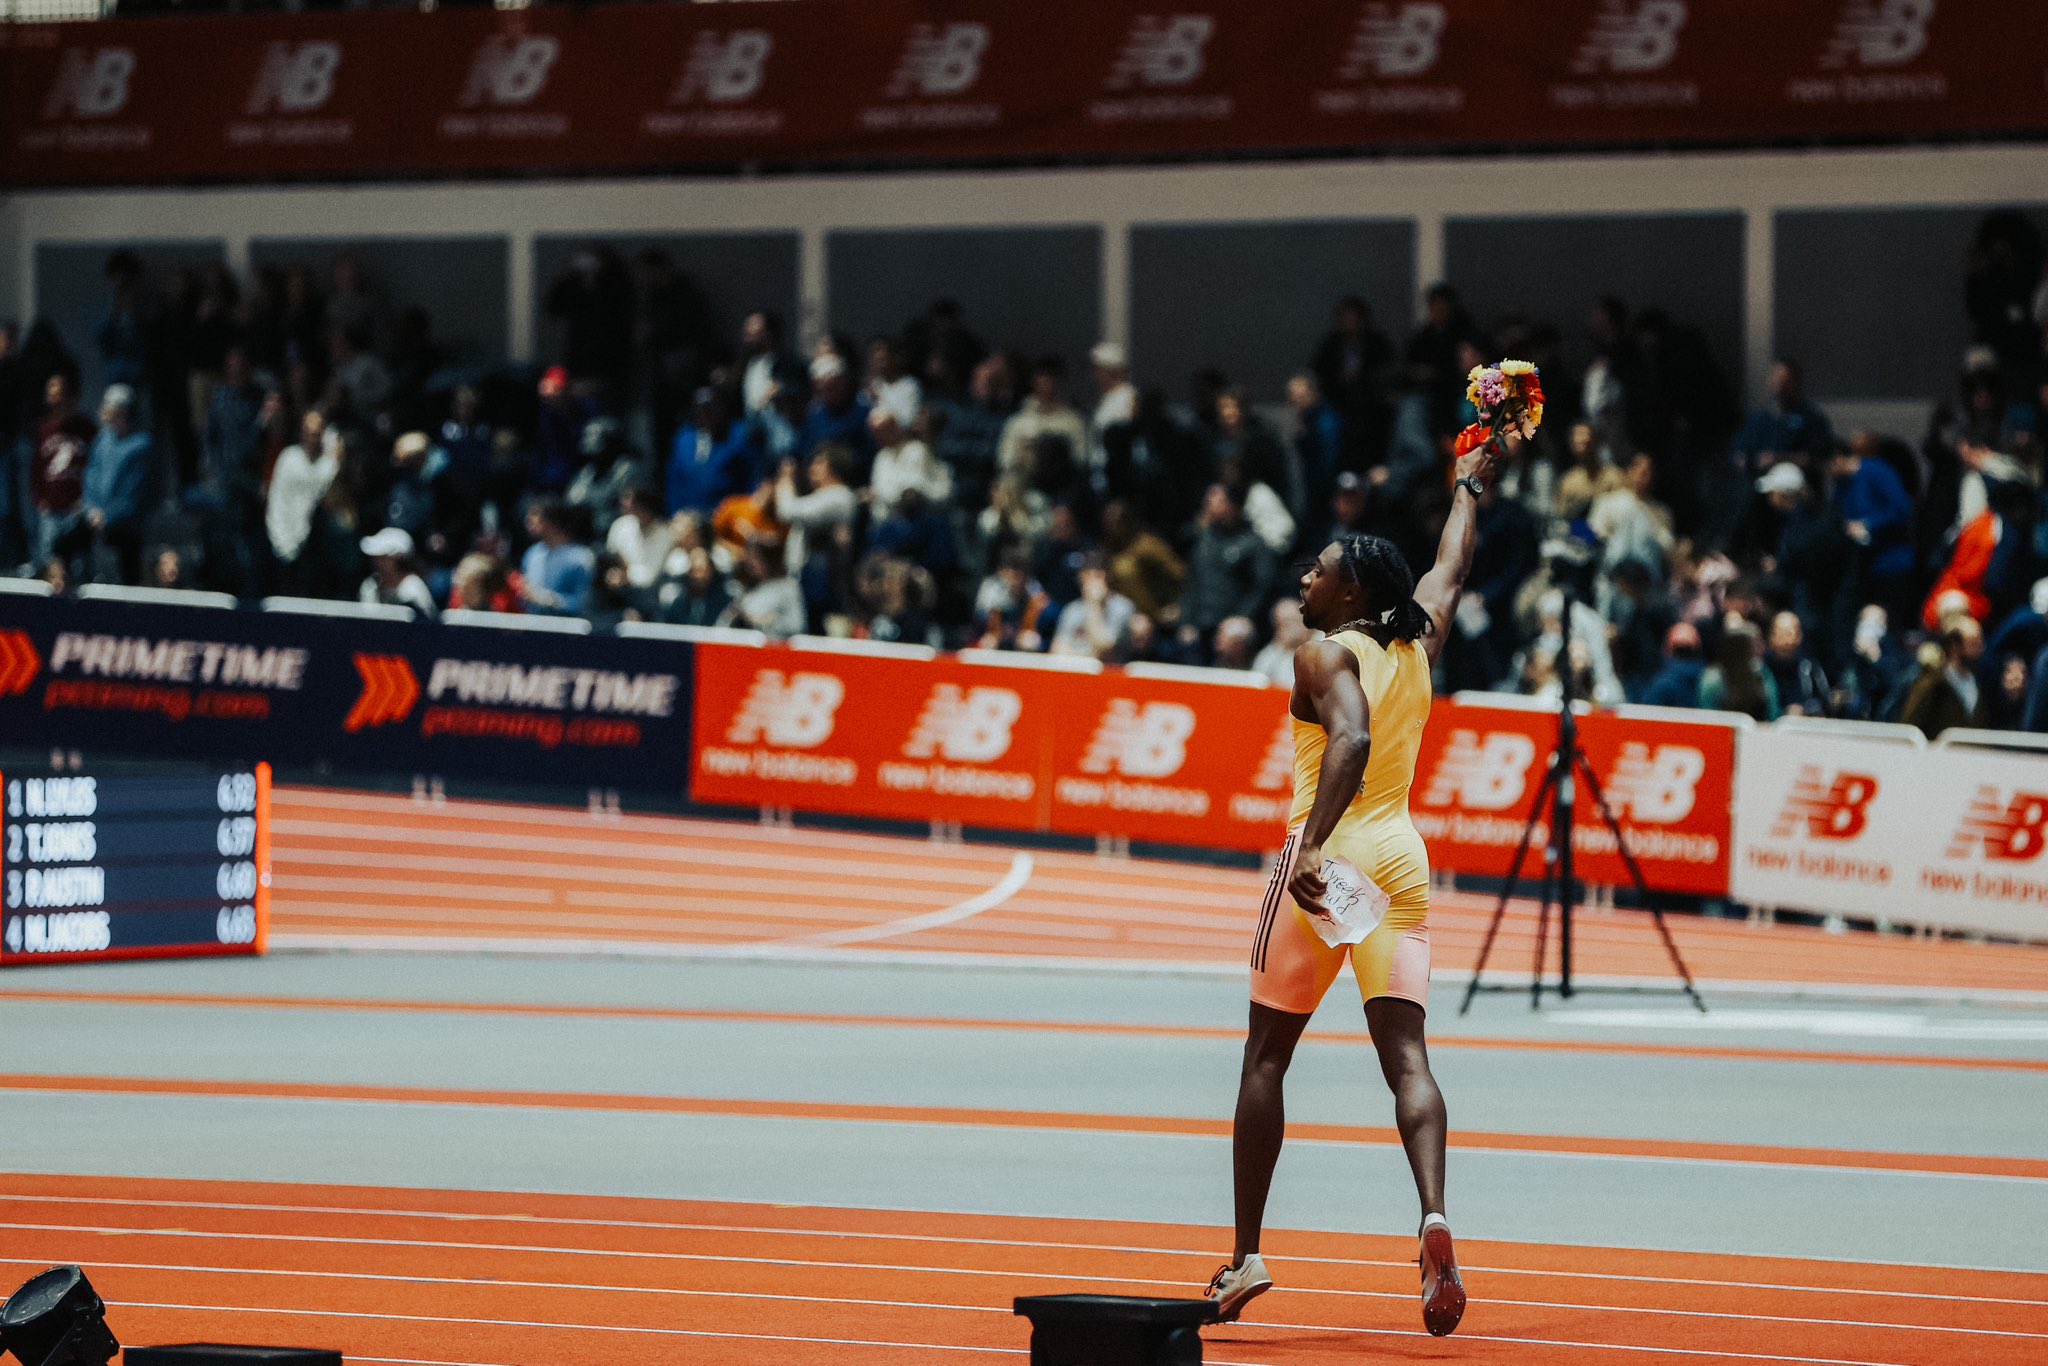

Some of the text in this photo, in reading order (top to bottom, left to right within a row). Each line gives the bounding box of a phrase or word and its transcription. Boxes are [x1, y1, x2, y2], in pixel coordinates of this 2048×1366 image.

[52, 631, 309, 690] PRIMETIME
[427, 658, 679, 717] PRIMETIME
[726, 669, 844, 748] NB
[902, 683, 1022, 762] NB
[1079, 697, 1196, 778] NB
[1421, 729, 1535, 810] NB
[1594, 742, 1705, 824] NB
[1770, 763, 1879, 841] NB
[7, 824, 23, 863] 2
[1945, 784, 2048, 862] NB
[7, 869, 23, 909] 3
